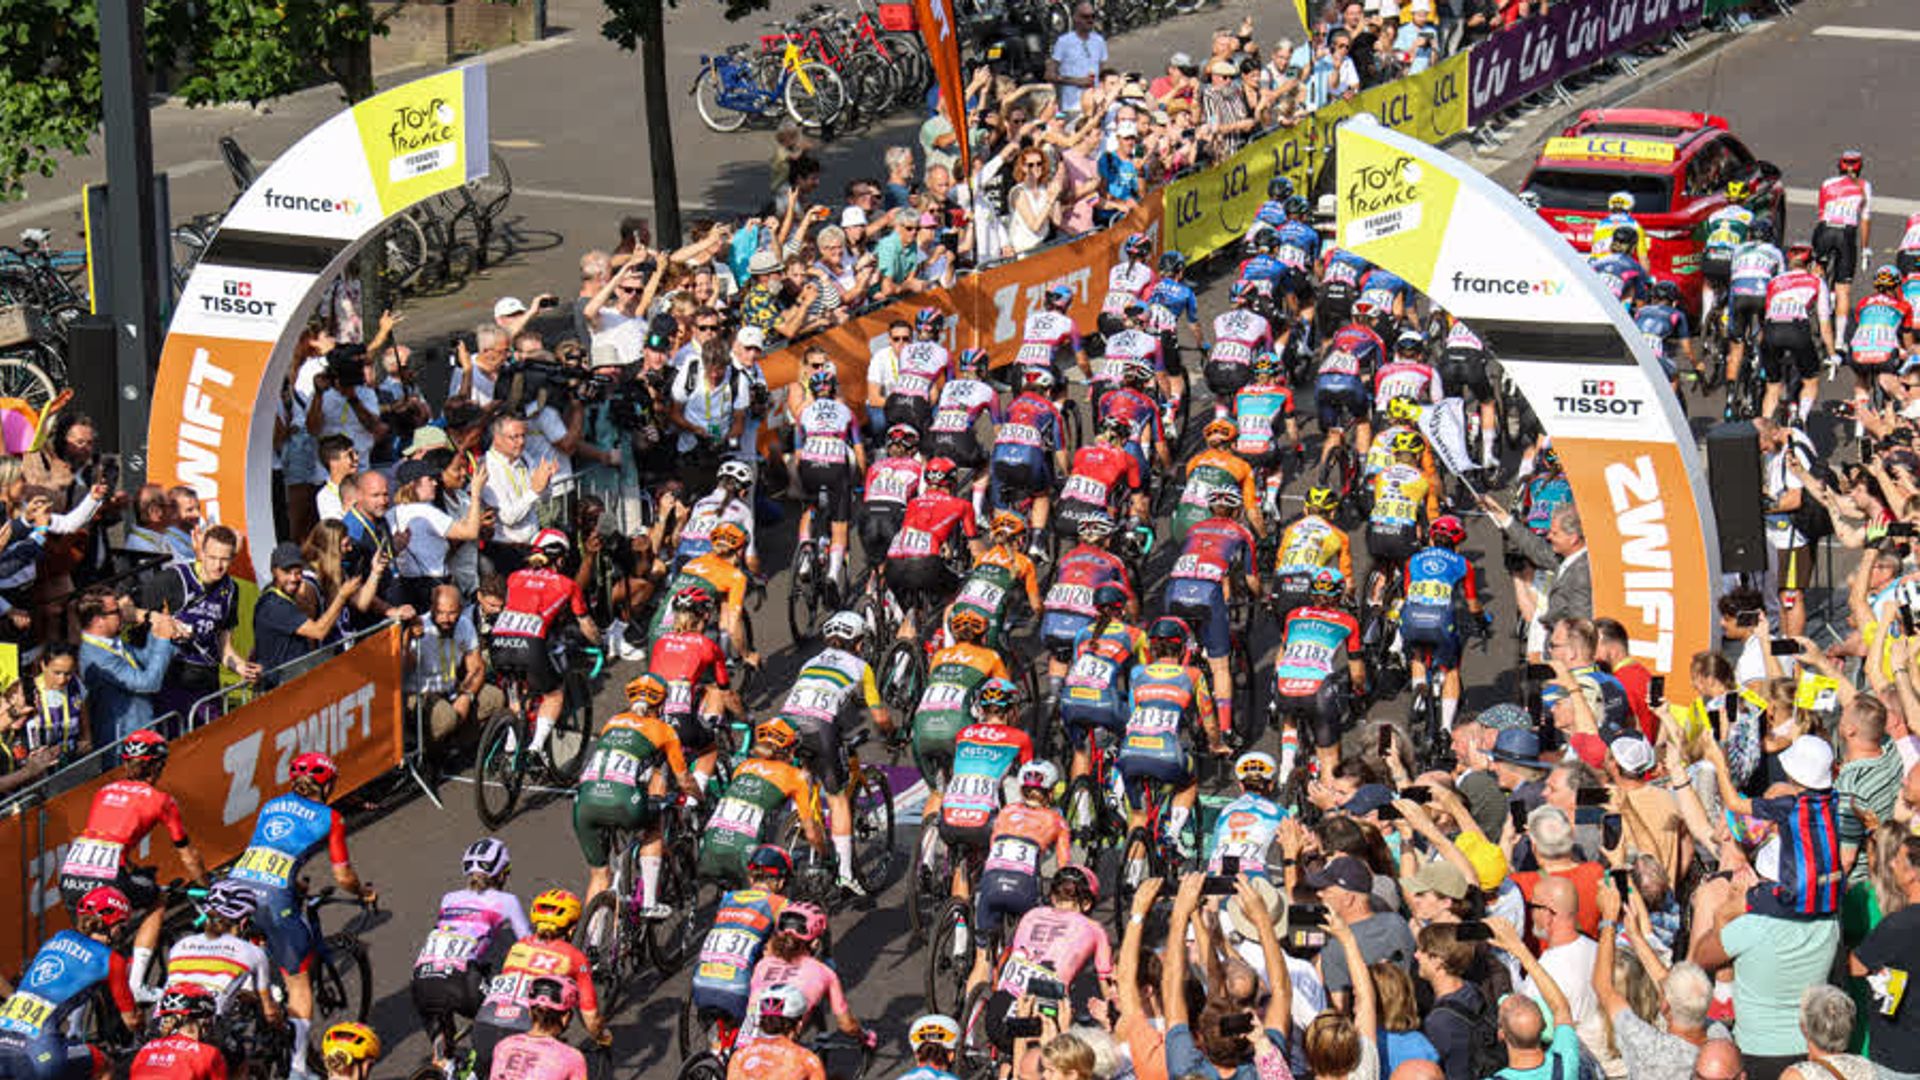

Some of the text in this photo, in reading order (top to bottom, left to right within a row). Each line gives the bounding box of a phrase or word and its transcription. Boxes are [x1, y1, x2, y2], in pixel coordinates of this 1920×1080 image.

[1566, 7, 1604, 58] Liv
[1519, 25, 1557, 81] Liv
[1433, 72, 1458, 107] LCL
[1473, 52, 1512, 108] Liv
[1381, 93, 1413, 128] LCL
[1587, 140, 1635, 155] LCL
[1222, 164, 1249, 201] LCL
[1176, 187, 1203, 229] LCL
[200, 294, 278, 317] TISSOT
[1553, 396, 1645, 416] TISSOT
[1604, 455, 1675, 673] ZWIFT
[812, 692, 830, 709] 75
[275, 683, 376, 786] ZWIFT
[951, 809, 982, 821] CAPS
[1015, 845, 1027, 860] 3
[265, 855, 287, 874] 97
[1029, 923, 1068, 943] EF
[762, 965, 800, 983] EF
[20, 1001, 43, 1023] 94
[505, 1055, 539, 1074] EF
